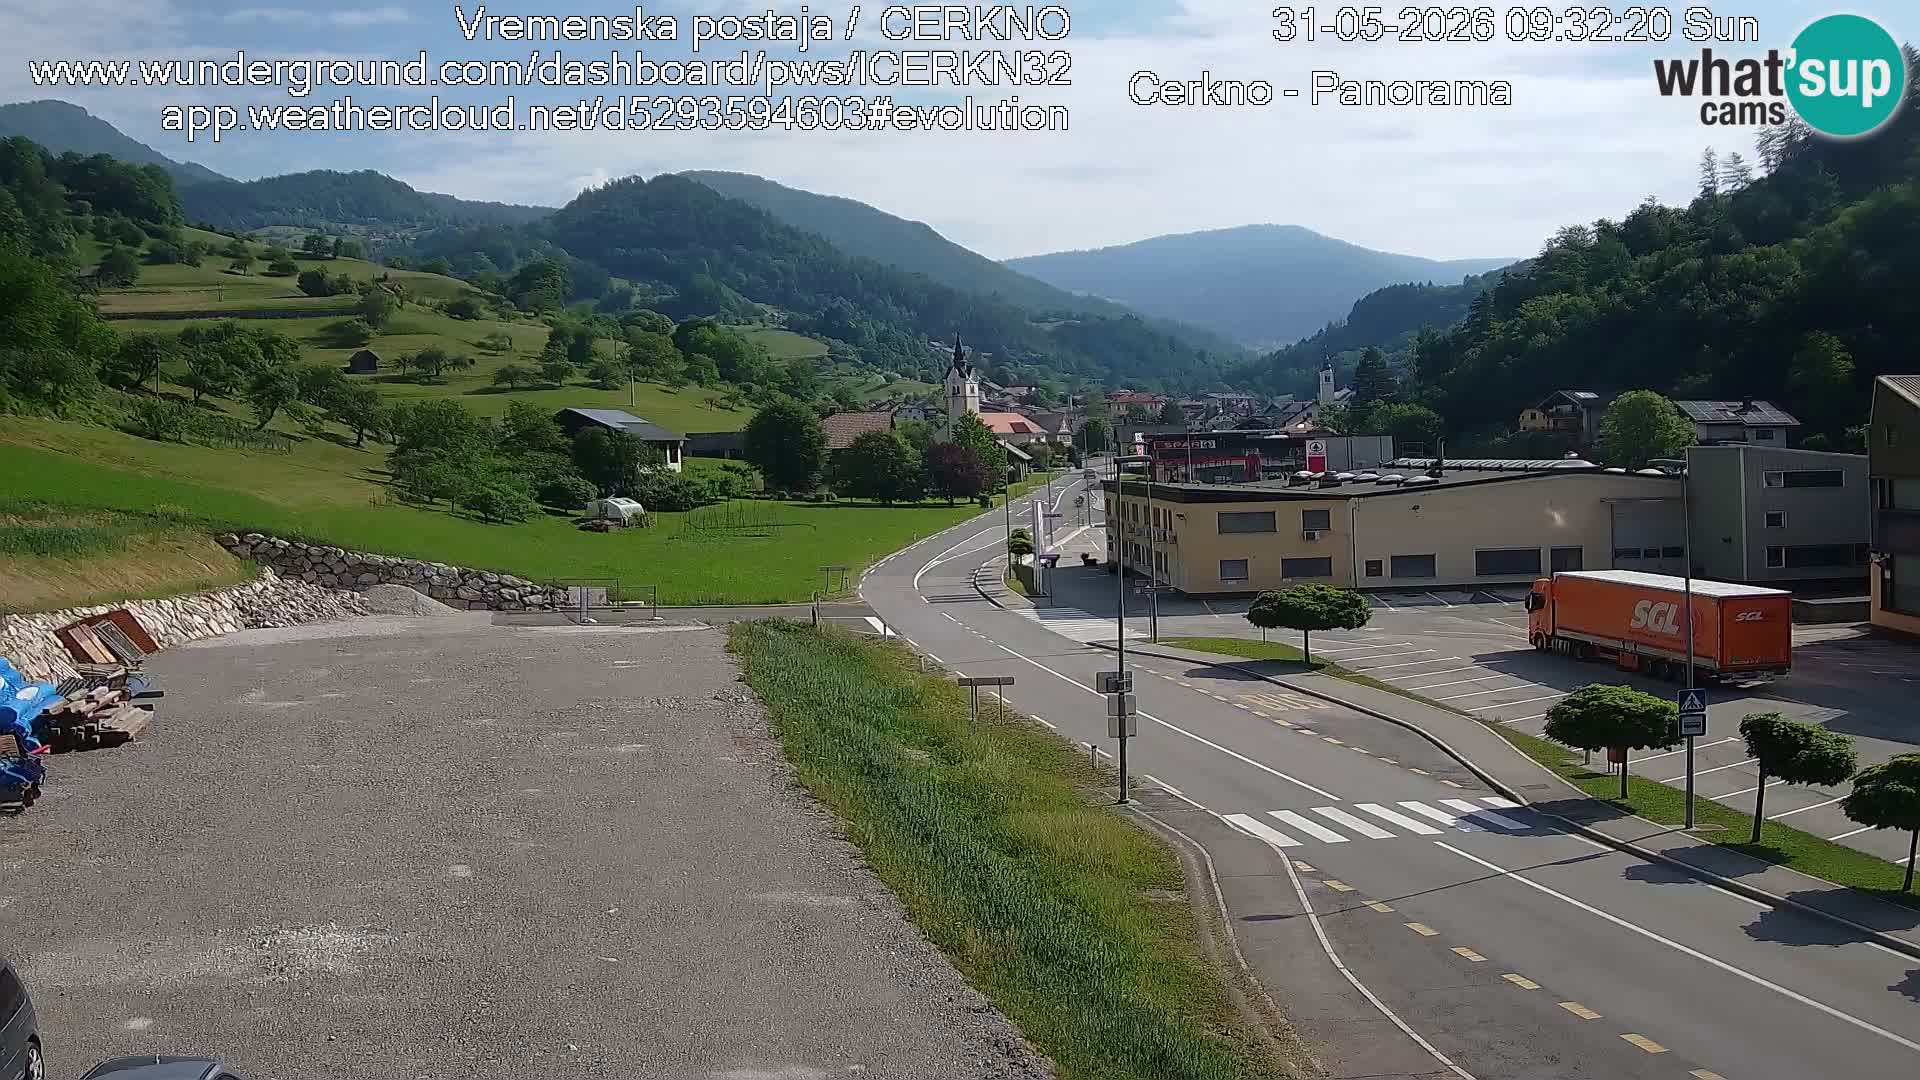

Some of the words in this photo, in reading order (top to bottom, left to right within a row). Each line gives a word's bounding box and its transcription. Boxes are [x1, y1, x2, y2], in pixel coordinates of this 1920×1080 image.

[1163, 440, 1200, 449] SPAR
[1630, 599, 1680, 635] SGL
[1735, 611, 1763, 622] SGL
